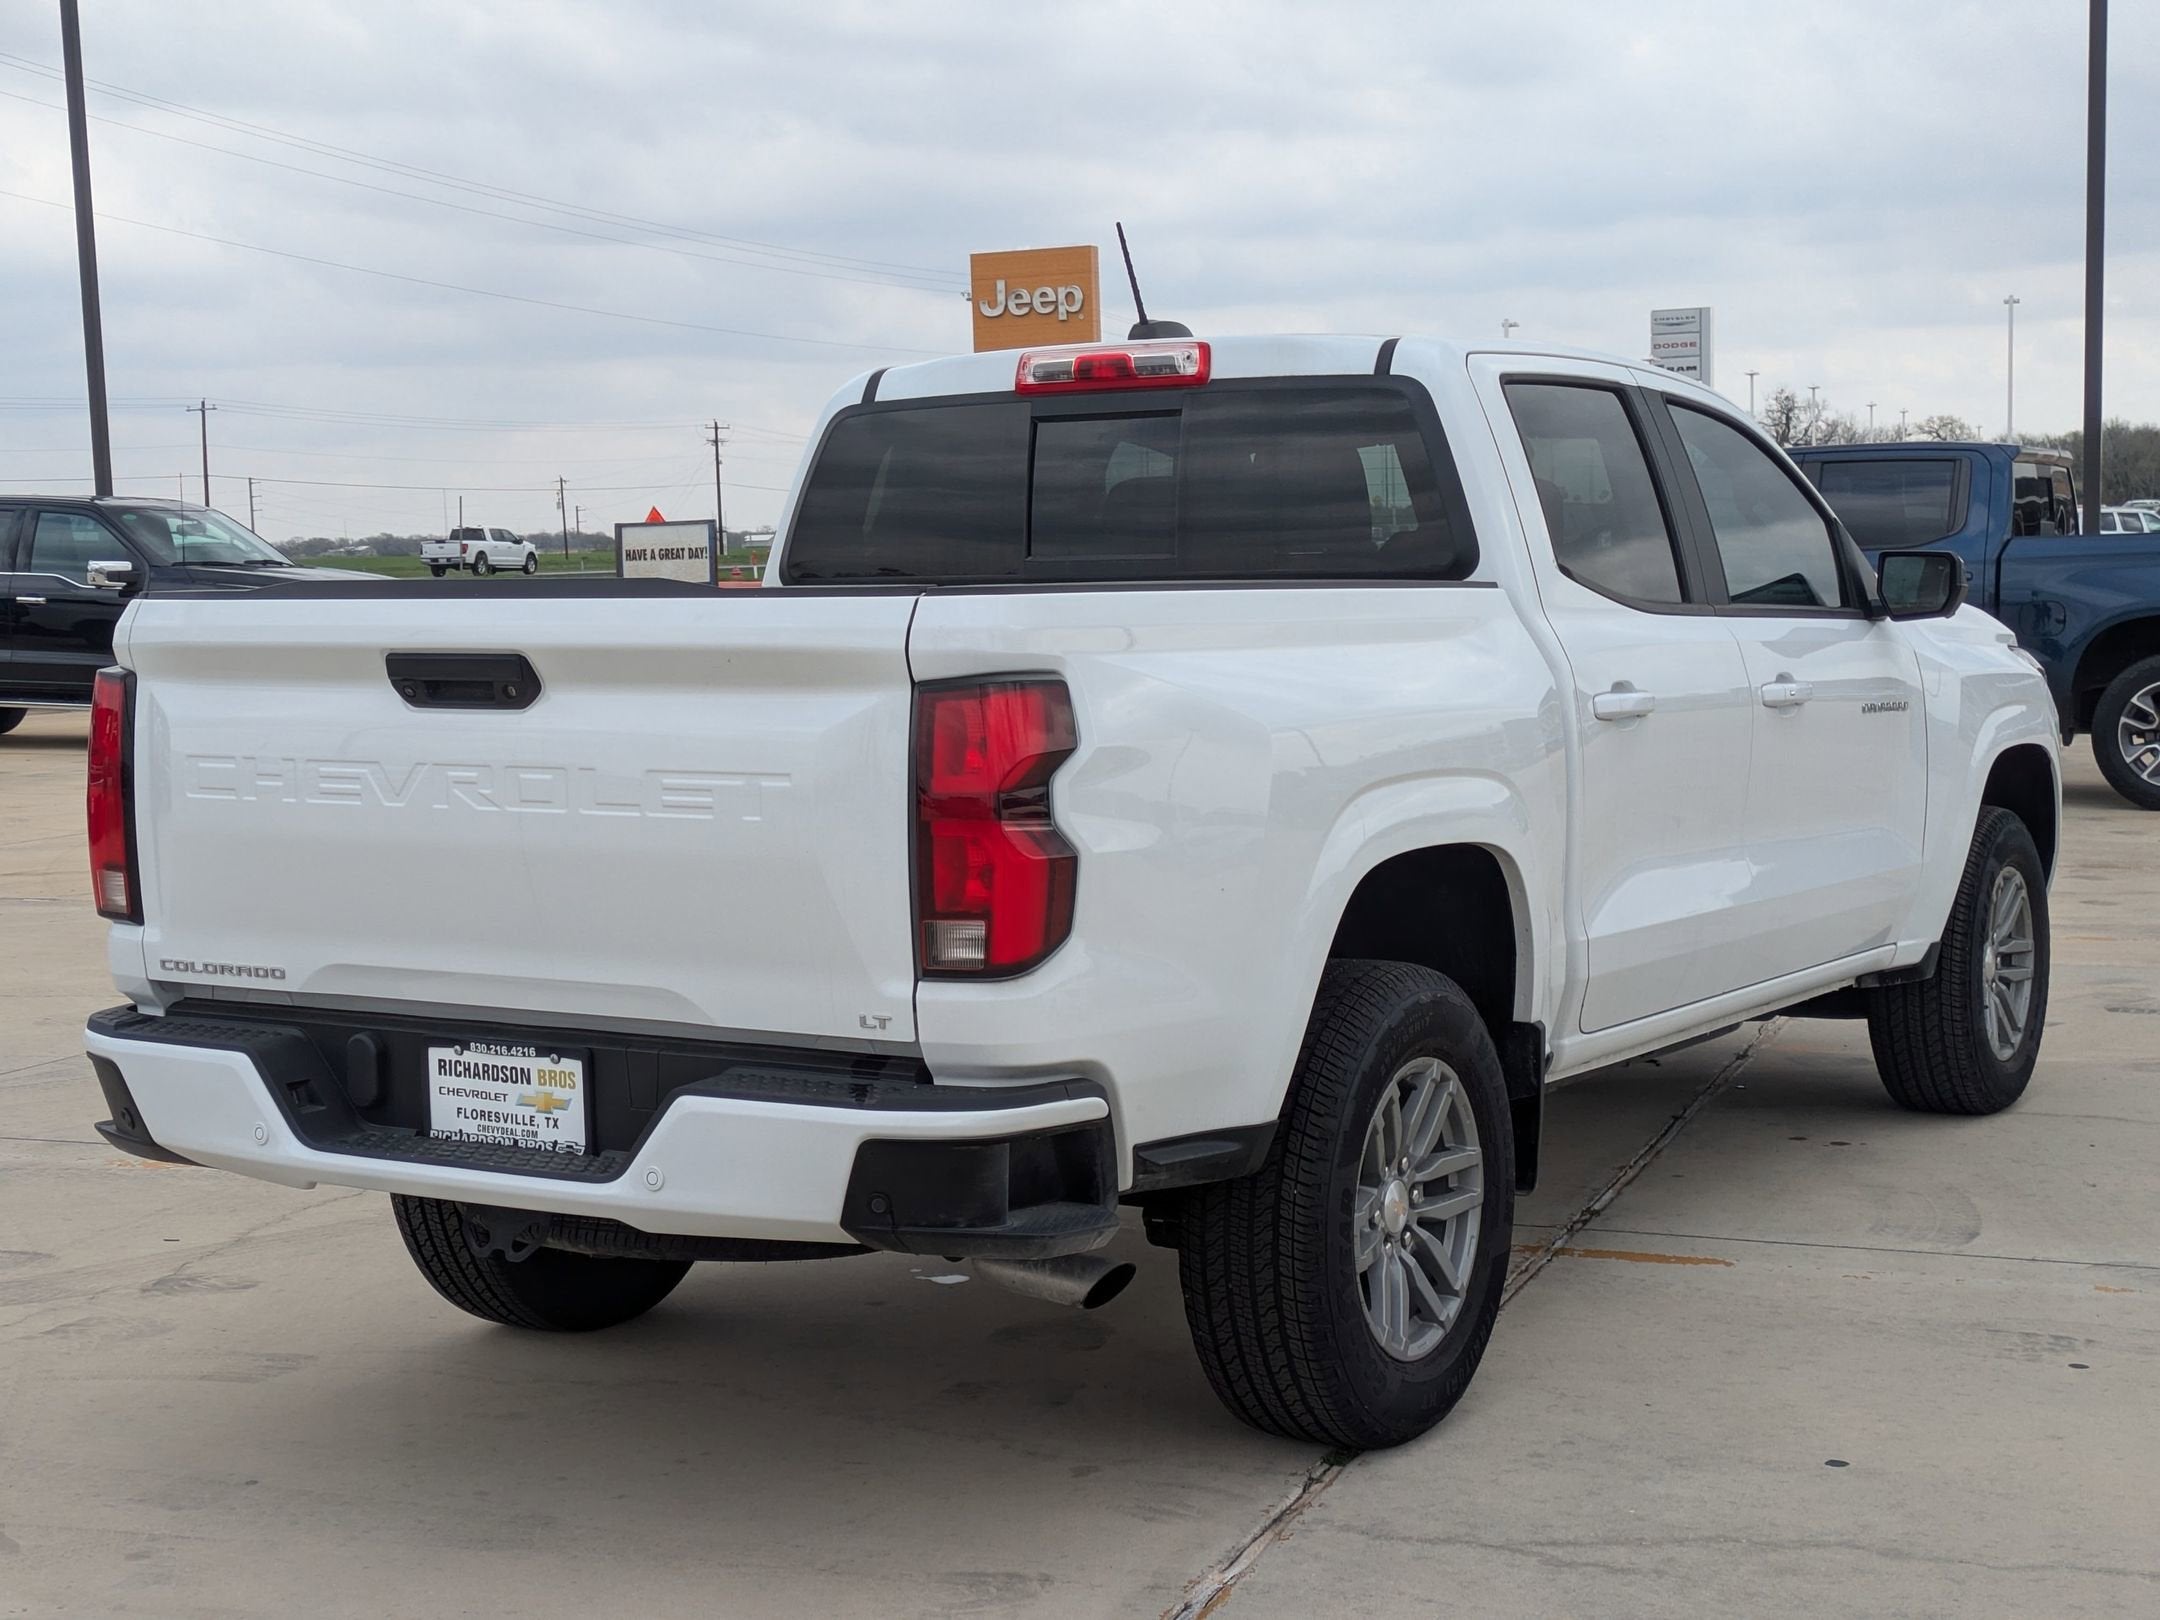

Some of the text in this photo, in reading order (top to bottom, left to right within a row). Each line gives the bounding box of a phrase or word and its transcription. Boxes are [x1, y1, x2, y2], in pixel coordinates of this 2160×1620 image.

[979, 279, 1084, 321] Jeep
[1653, 341, 1697, 350] DODGE
[625, 546, 708, 561] HAVE A GREAT DAY!
[185, 753, 793, 822] CHEVROLET
[160, 959, 287, 980] COLORADO
[859, 1012, 892, 1030] LT
[470, 1042, 536, 1057] 830.216.4216
[438, 1058, 577, 1090] RICHARDSON BROS
[439, 1086, 508, 1102] CHEVROLET
[456, 1107, 560, 1130] FLORESVILLE, TX
[477, 1124, 539, 1139] CHEVYDEAL.COM
